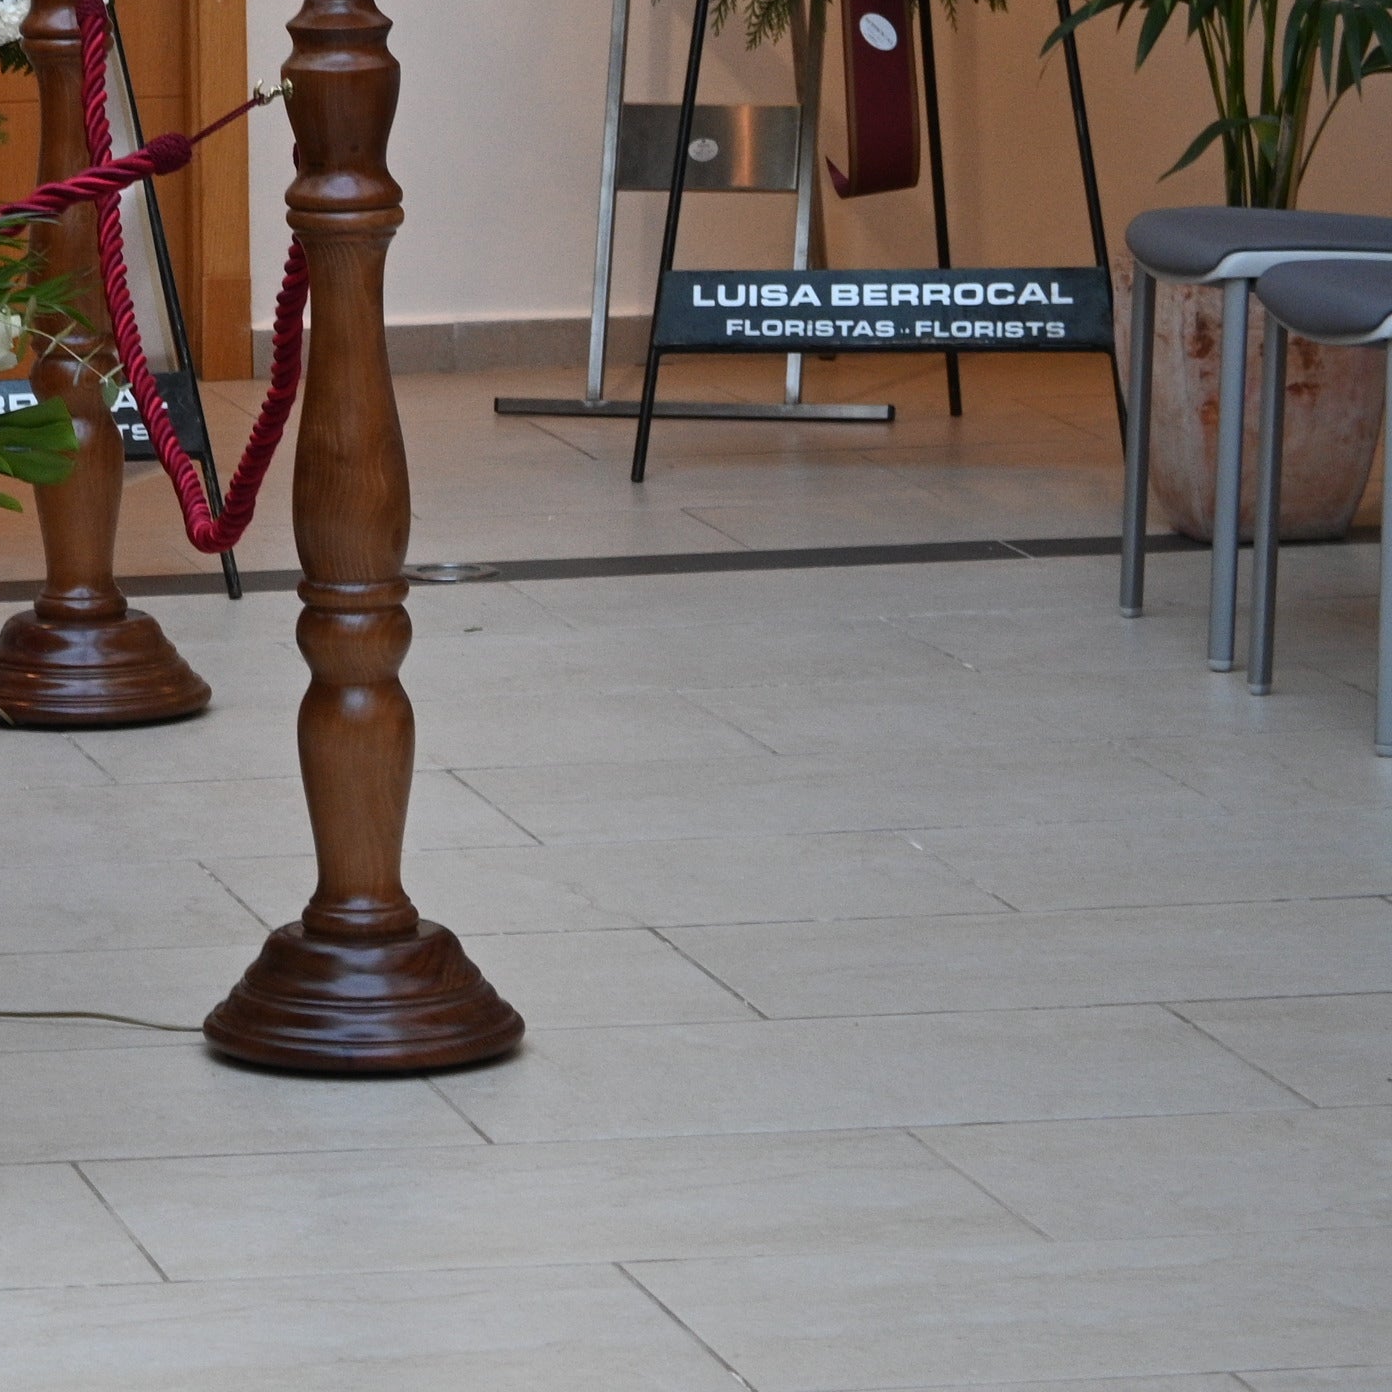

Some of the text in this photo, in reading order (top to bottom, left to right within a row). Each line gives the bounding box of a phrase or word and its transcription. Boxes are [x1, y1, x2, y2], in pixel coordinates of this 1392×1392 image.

[692, 281, 1075, 307] LUISA BERROCAL
[726, 319, 1067, 339] FLORISTAS FLORISTS
